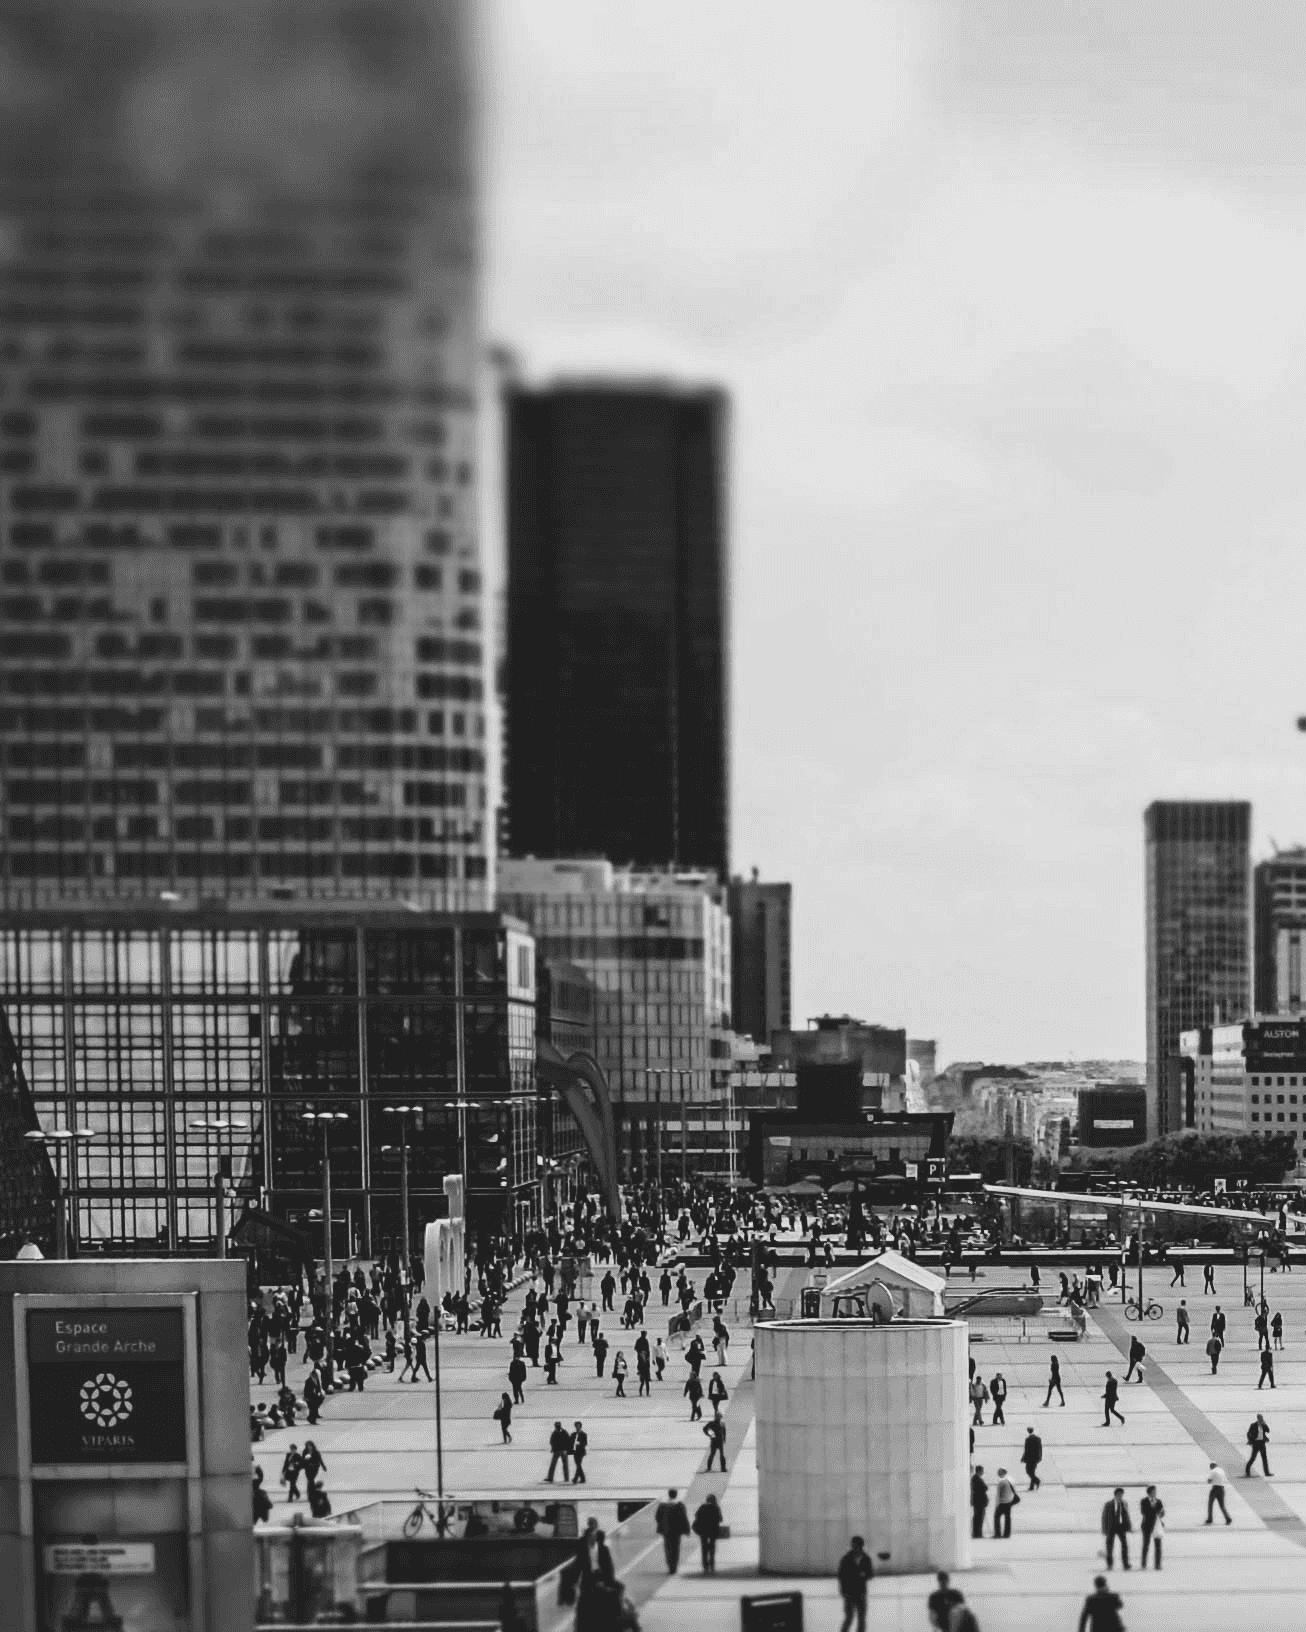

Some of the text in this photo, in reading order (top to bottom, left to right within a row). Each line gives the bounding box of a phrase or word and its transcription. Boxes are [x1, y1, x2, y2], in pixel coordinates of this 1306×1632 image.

[930, 1164, 937, 1175] P
[55, 1320, 108, 1336] Espace
[56, 1340, 156, 1353] Grande Arche
[81, 1434, 135, 1447] VIPARIS
